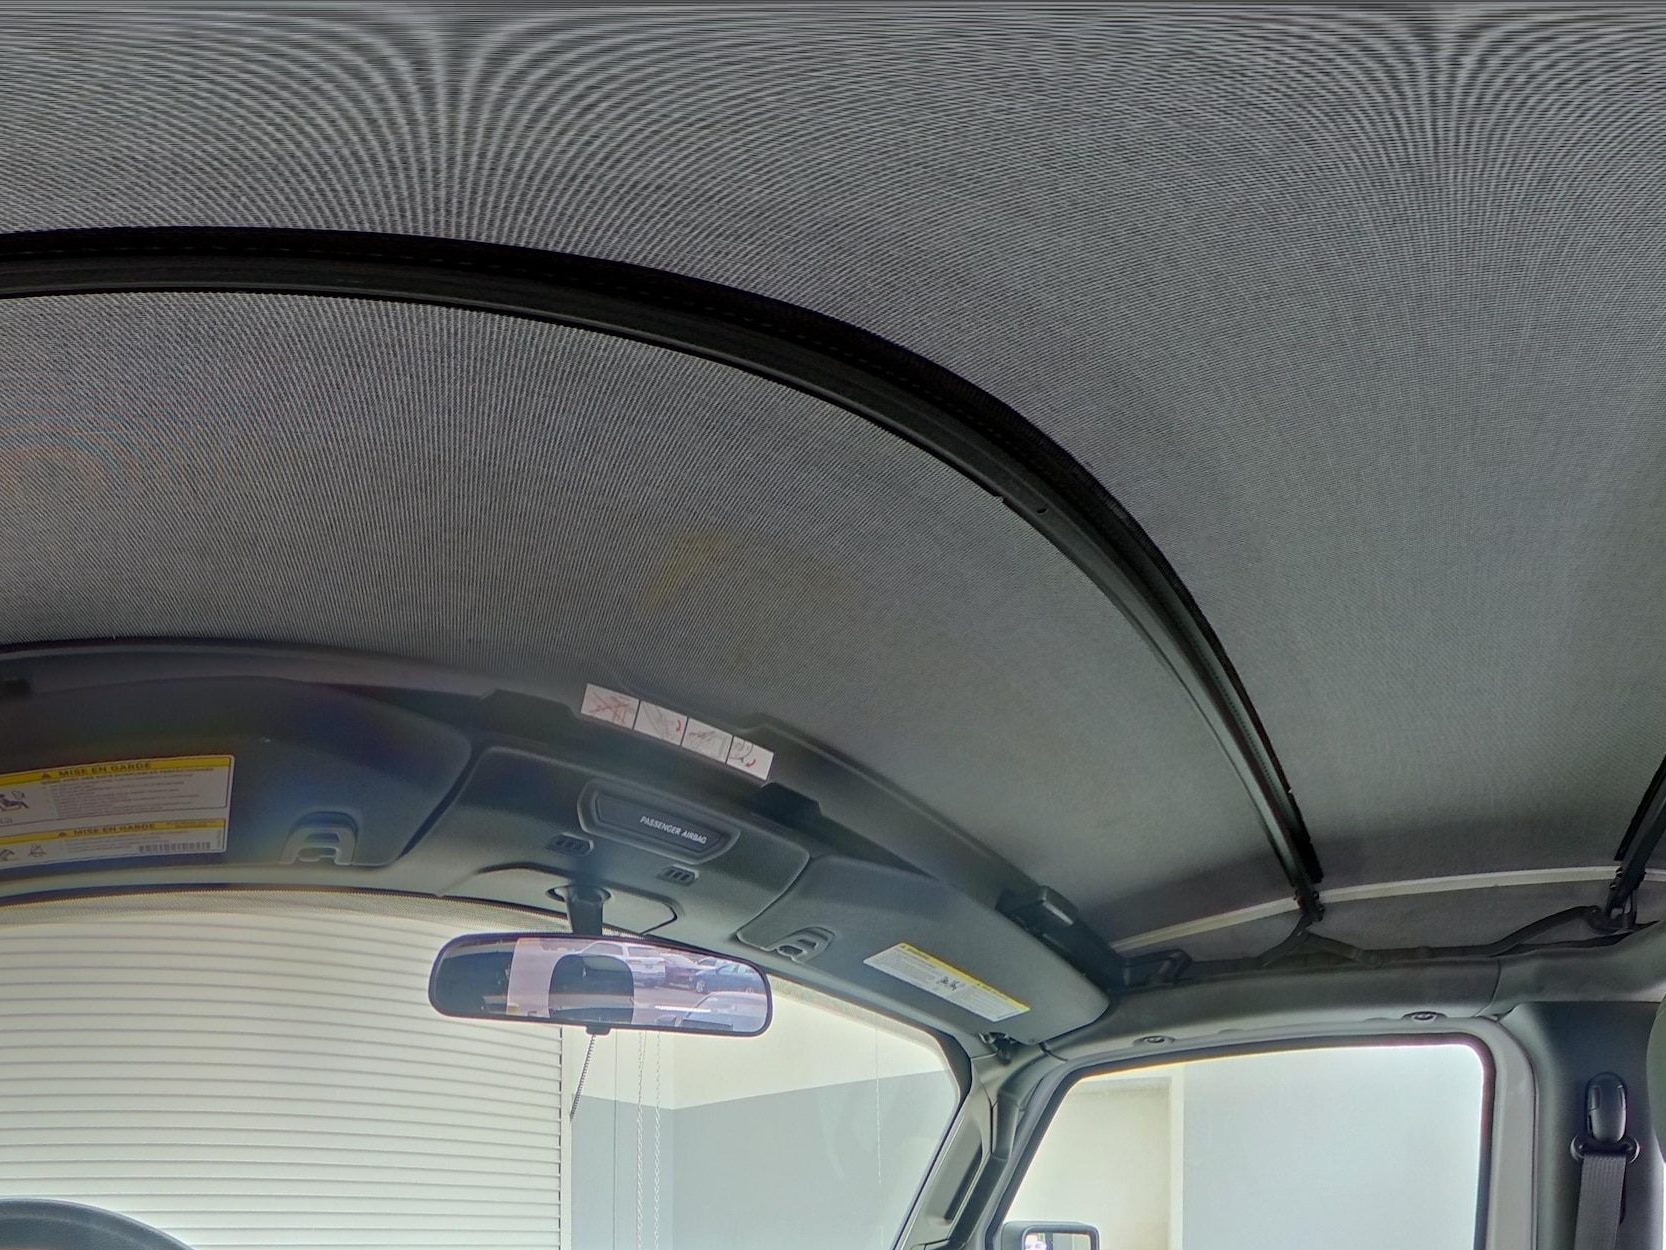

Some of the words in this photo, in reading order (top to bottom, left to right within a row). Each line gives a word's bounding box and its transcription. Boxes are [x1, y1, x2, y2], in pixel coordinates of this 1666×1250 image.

[59, 768, 89, 778] MISE
[91, 765, 107, 774] EN
[110, 762, 152, 773] GARDE
[640, 815, 682, 835] PASSENGER
[681, 830, 707, 844] AIRBAG
